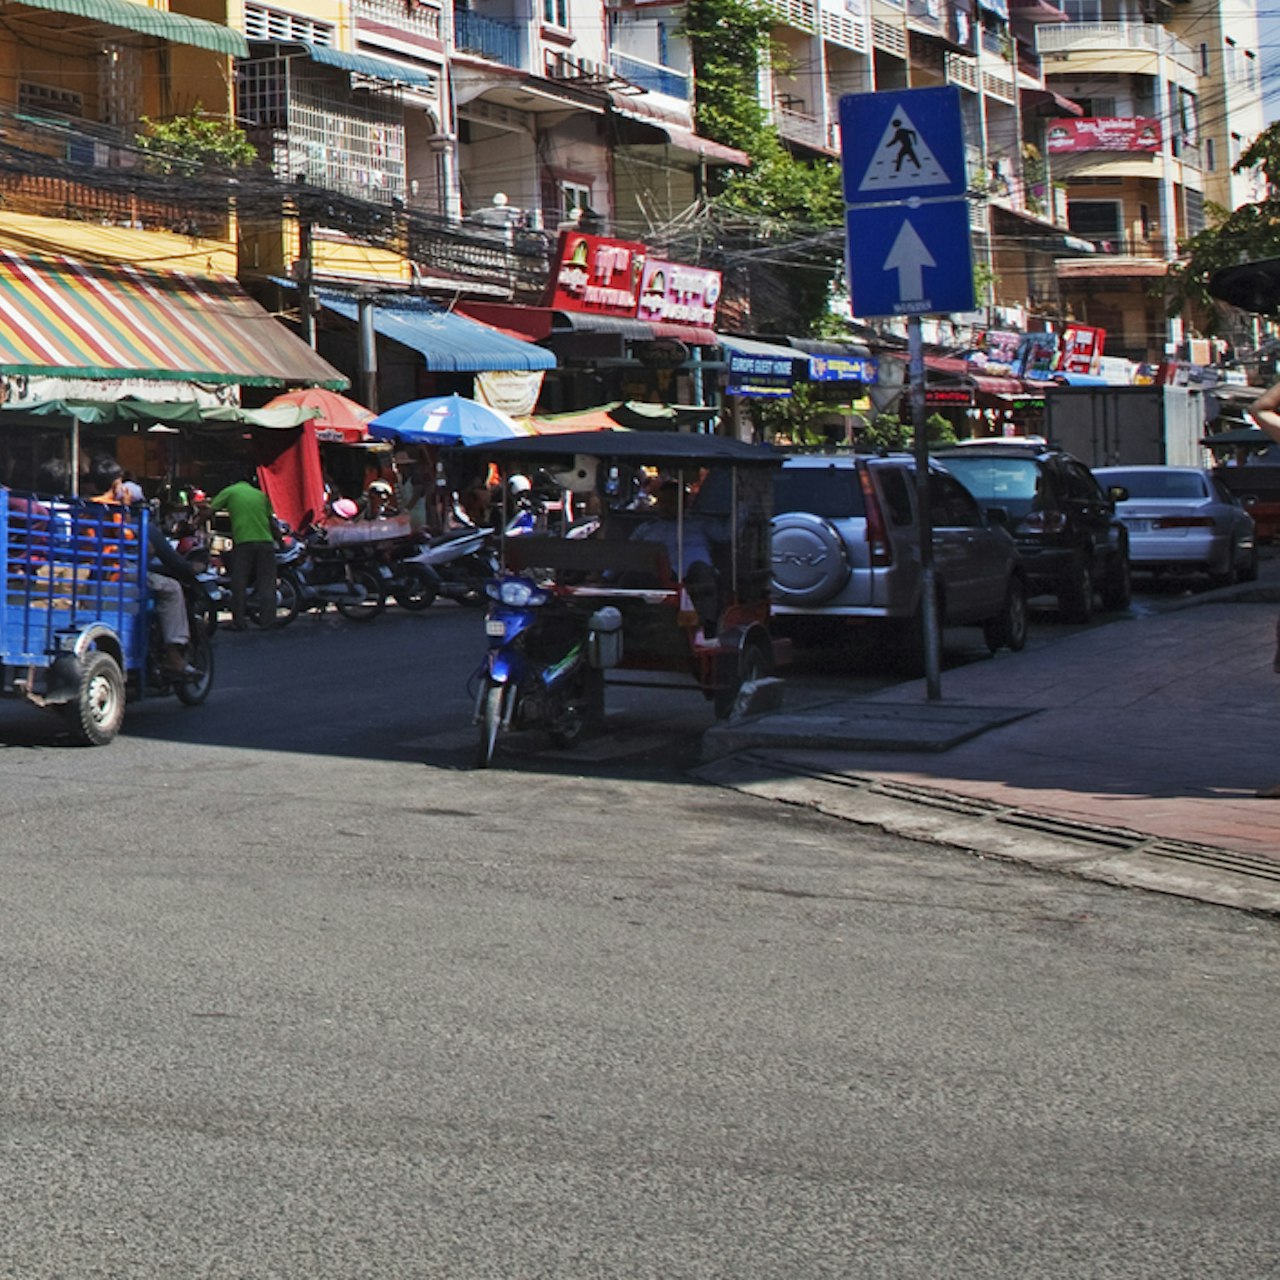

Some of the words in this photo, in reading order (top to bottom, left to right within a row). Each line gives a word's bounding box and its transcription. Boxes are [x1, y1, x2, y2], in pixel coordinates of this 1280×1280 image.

[731, 357, 755, 373] EUROPE
[754, 359, 773, 375] GUEST
[773, 361, 793, 376] HOUSE
